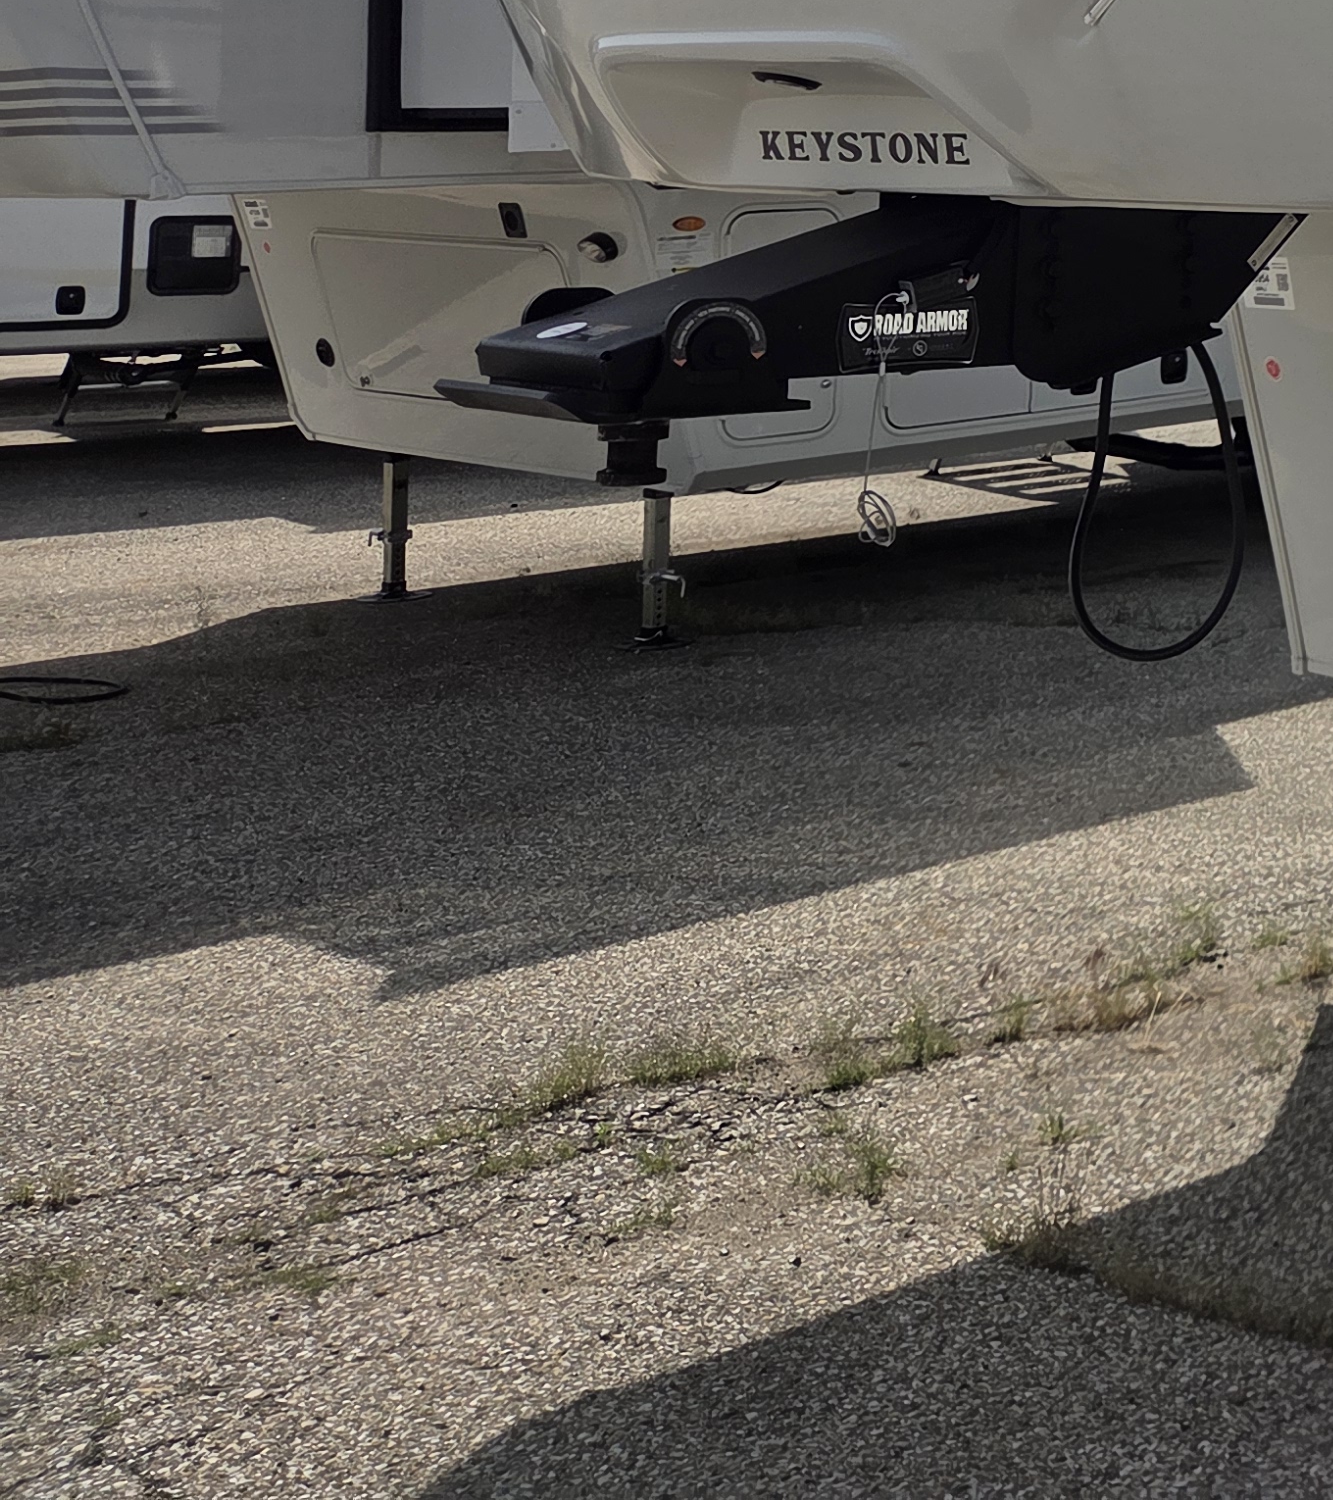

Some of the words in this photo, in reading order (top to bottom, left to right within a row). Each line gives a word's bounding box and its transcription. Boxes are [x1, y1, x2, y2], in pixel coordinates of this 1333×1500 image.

[758, 130, 971, 166] KEYSTONE
[873, 312, 914, 337] ROAD
[915, 309, 969, 334] ARMOR
